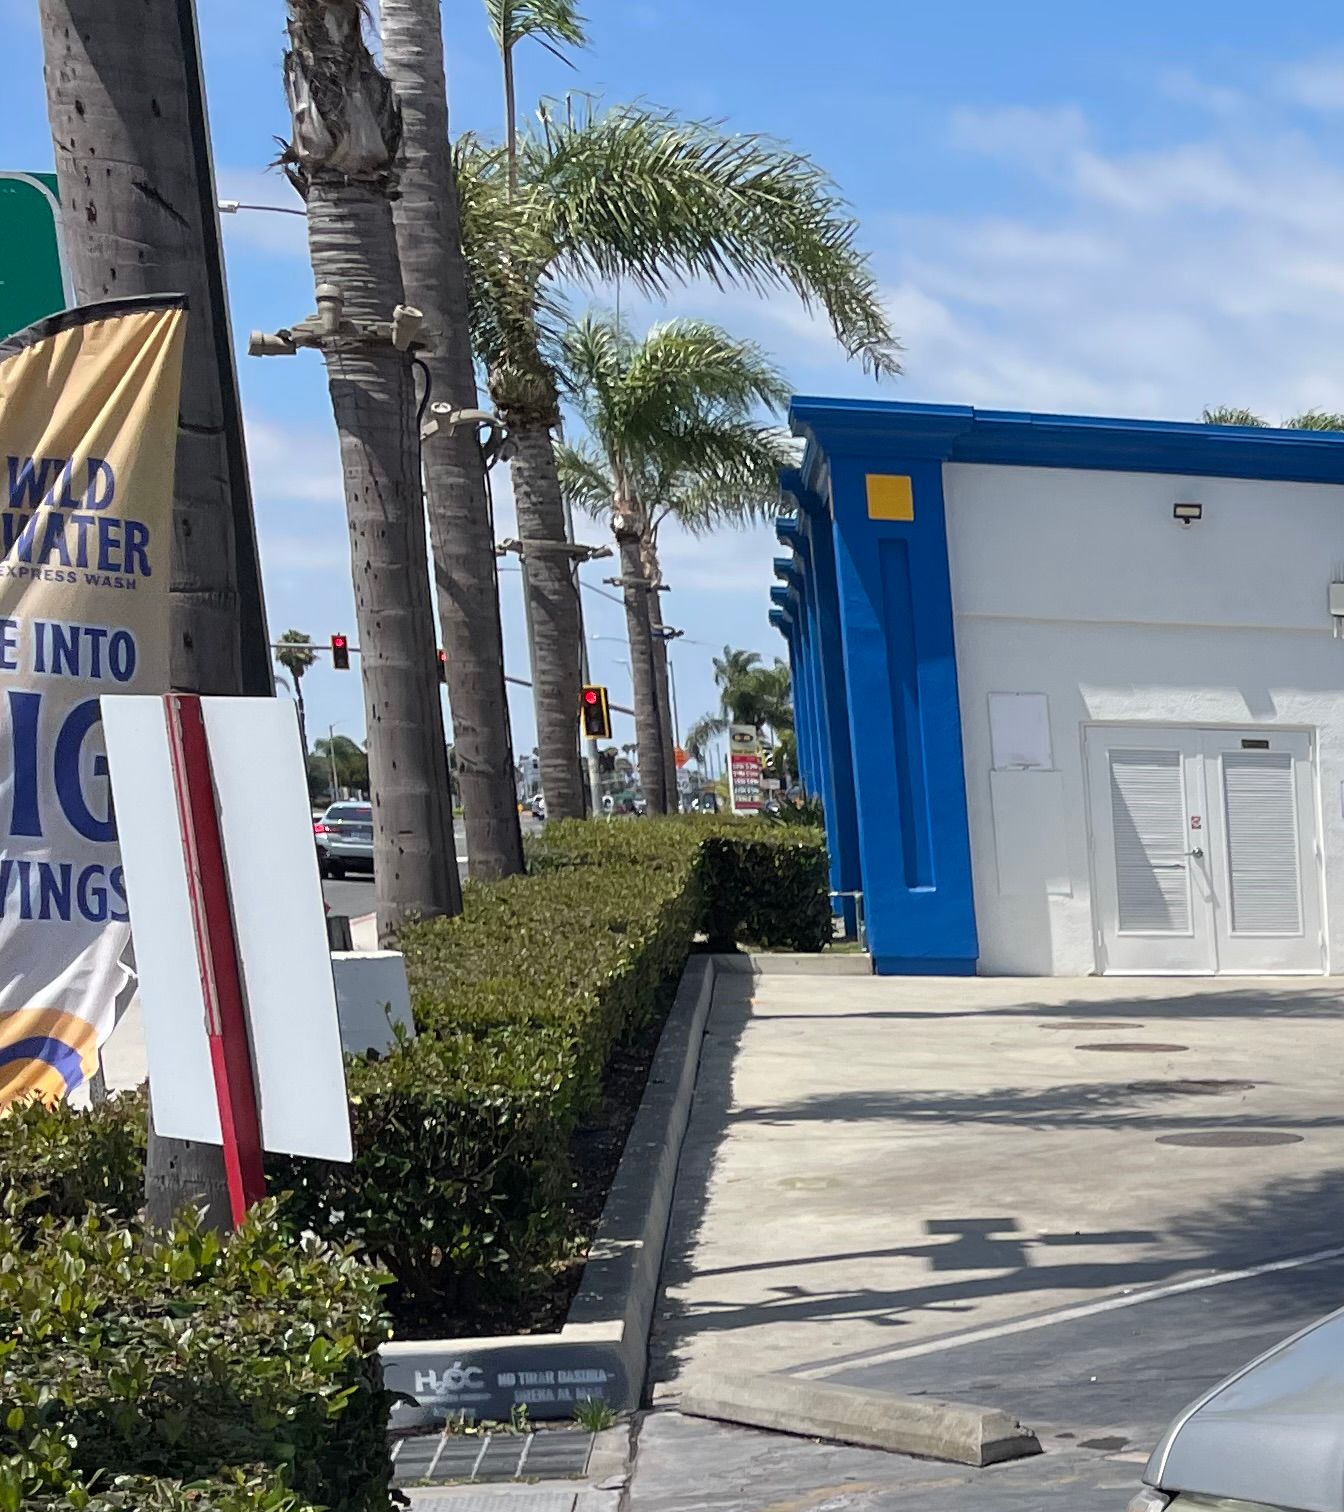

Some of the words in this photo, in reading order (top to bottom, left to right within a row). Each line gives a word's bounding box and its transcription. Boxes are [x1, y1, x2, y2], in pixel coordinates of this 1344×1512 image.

[7, 455, 115, 510] WILD
[1, 512, 152, 576] WATER
[84, 573, 136, 590] WASH
[34, 622, 136, 682] INTO
